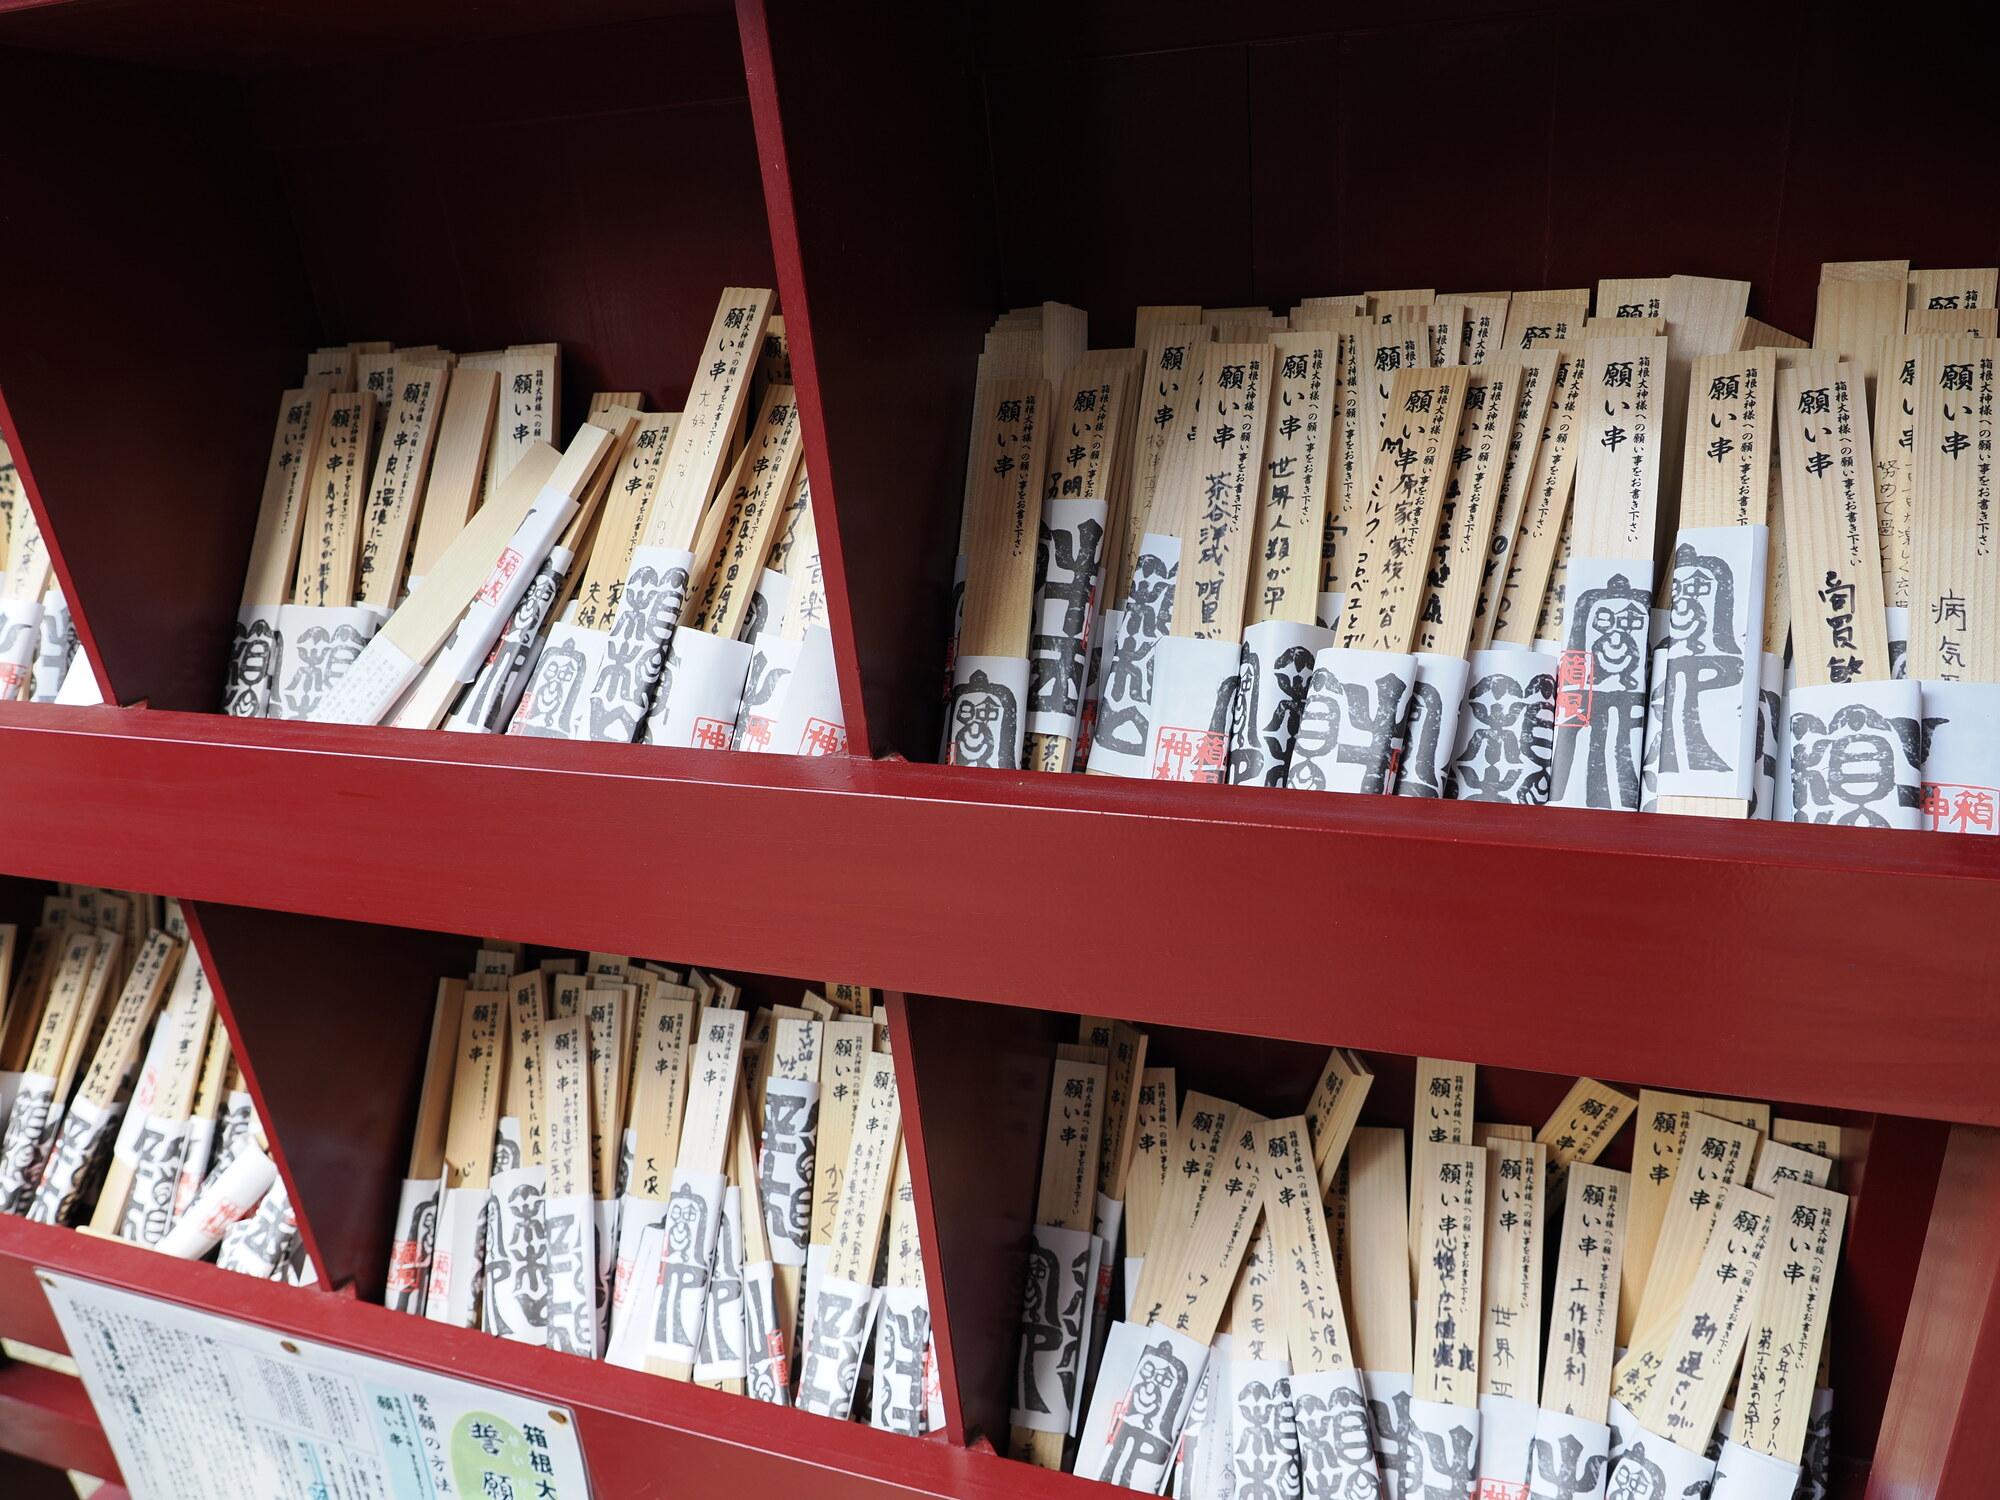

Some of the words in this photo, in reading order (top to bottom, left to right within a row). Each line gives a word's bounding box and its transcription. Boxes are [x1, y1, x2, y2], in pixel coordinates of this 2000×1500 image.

[702, 303, 758, 457] 箱根大神様への願い事をお書き下さい
[709, 307, 747, 383] 願い串
[393, 383, 422, 452] 願い串
[512, 373, 533, 445] 願い串
[1154, 346, 1185, 430] 願い串
[1213, 364, 1246, 450] 願い串
[1279, 354, 1309, 441] 願い串
[1600, 361, 1634, 453] 願い串
[1707, 374, 1741, 464] 願い串
[1939, 364, 1975, 461] 願い串
[278, 405, 303, 471] 願い串
[326, 408, 351, 474] 願い串
[624, 429, 659, 497] 願い串
[753, 405, 791, 479] 願い串
[993, 399, 1022, 479] 願い串
[1066, 389, 1097, 468] 願い串
[1229, 361, 1260, 533] 箱根大神様への願い事をお書き下さい
[1300, 349, 1323, 526] 箱根大神様への願い事をお書き下さい
[1394, 389, 1435, 473] 願い串
[1531, 358, 1586, 540] 箱根大神様への願い事をお書き下さい
[1627, 356, 1651, 543] 箱根大神様への願い事をお書き下さい
[1735, 368, 1758, 527] 箱根大神様への願い事をお書き下
[1797, 387, 1834, 480] 願い串
[1976, 358, 1994, 557] 箱根大神様への願い事をお書き下さい
[1012, 396, 1036, 557] 箱根大神様への願い事をお書き下さい
[1459, 381, 1504, 554] 箱根大神様への願い事をお書き下さい
[1834, 380, 1862, 567] 箱根大神様への願い事をお書き下さい
[469, 1005, 489, 1063] 願い串
[518, 988, 532, 1046] 願い串
[589, 1005, 606, 1065] 願い串
[655, 1014, 674, 1076] 願い串
[555, 1033, 570, 1093] 願い串
[703, 1025, 726, 1086] 願い串
[833, 1039, 853, 1102] 願い串
[865, 1071, 891, 1135] 願い串
[1059, 1078, 1084, 1147] 願い串
[1138, 1085, 1156, 1154] 願い串
[1428, 1077, 1452, 1143] 願い串
[1556, 1098, 1607, 1151] 願い串
[1182, 1111, 1214, 1179] 願い串
[1268, 1135, 1296, 1208] 願い串
[1650, 1111, 1677, 1186] 願い串
[1690, 1137, 1728, 1211] 願い串
[1438, 1163, 1462, 1236] 願い串
[1499, 1158, 1522, 1232] 願い串
[1578, 1184, 1606, 1257] 願い串
[1717, 1210, 1760, 1285] 願い串
[1783, 1205, 1818, 1286] 願い串
[412, 1392, 453, 1494] 誓願の方法
